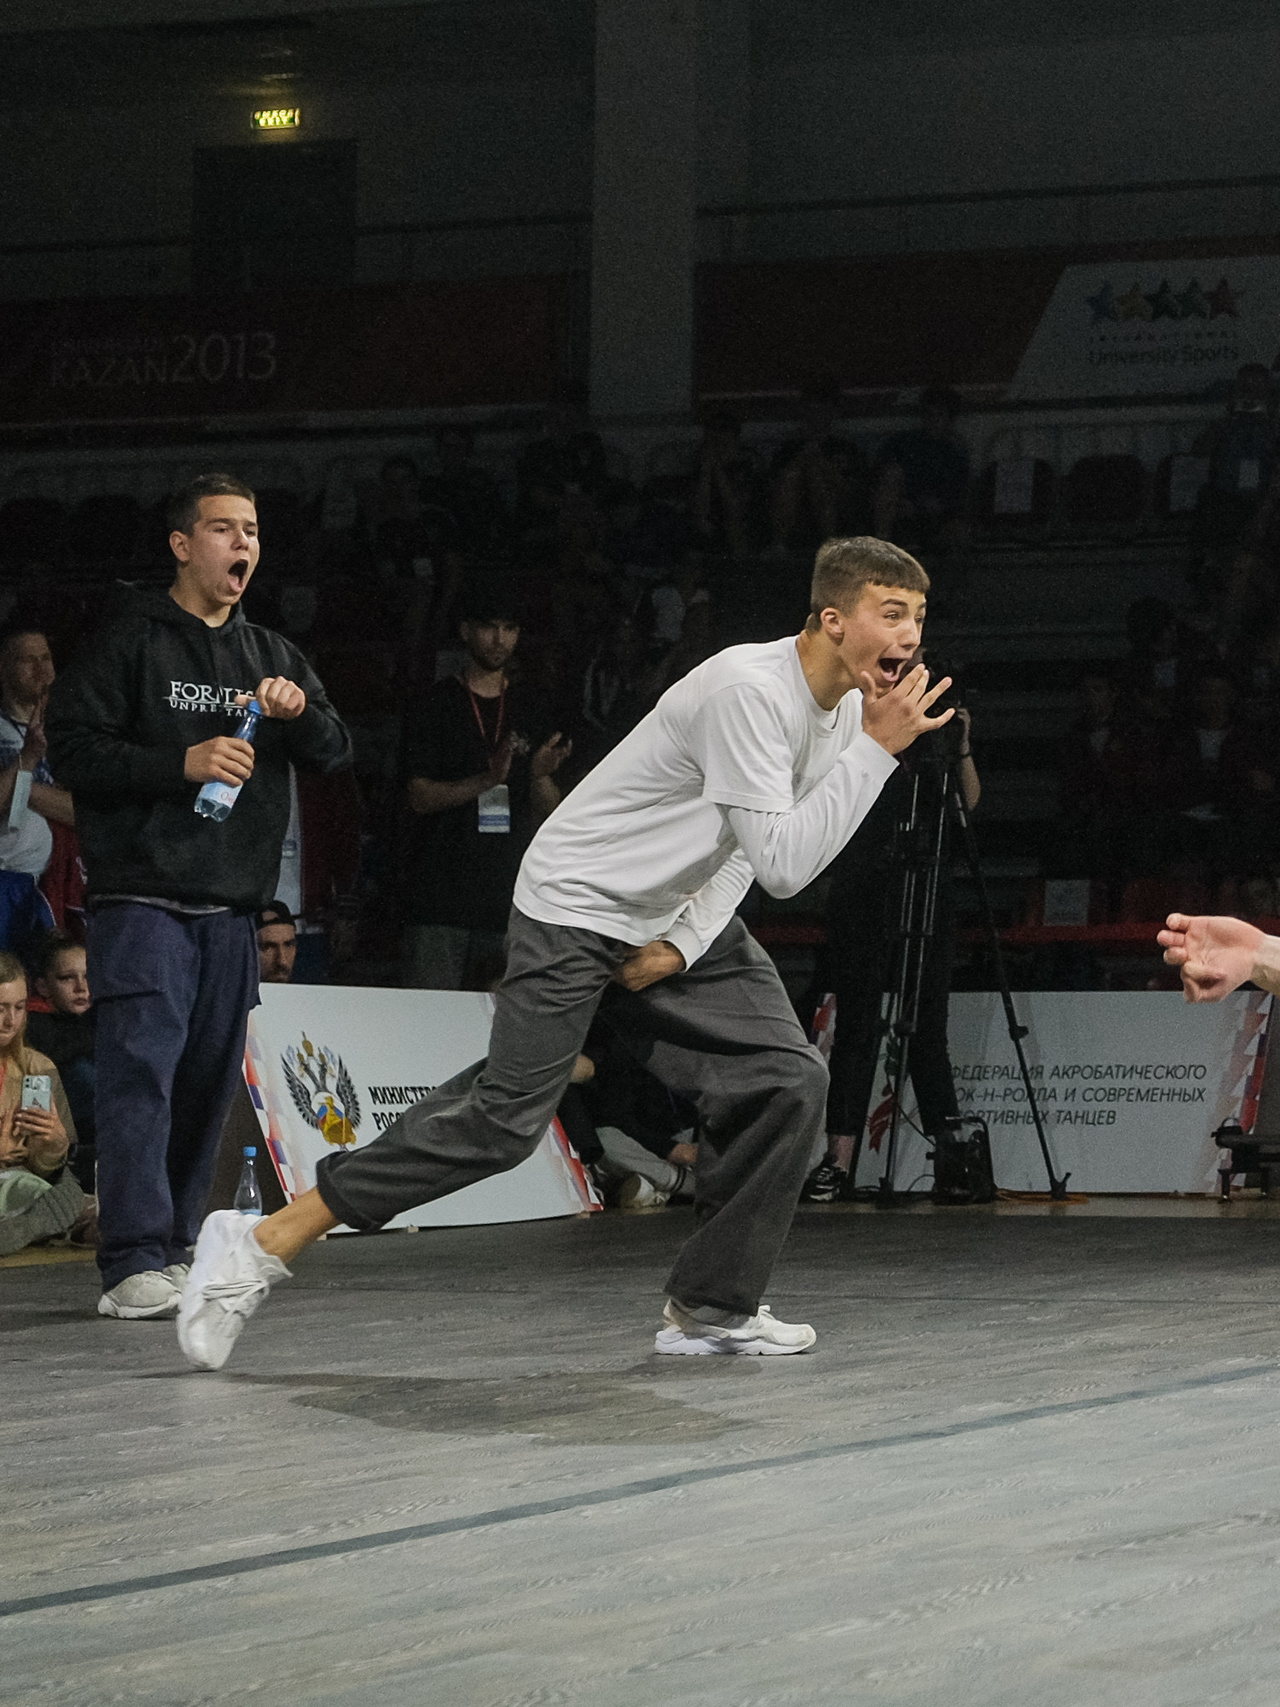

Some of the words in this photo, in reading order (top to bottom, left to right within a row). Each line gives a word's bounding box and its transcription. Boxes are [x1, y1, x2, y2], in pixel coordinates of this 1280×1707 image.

[51, 356, 168, 388] KAZAN
[171, 331, 276, 384] 2013
[1050, 1064, 1207, 1080] АКРОБАТИЧЕСКОГО
[1064, 1087, 1077, 1102] И
[1082, 1087, 1206, 1103] СОВРЕМЕННЫХ
[1056, 1110, 1117, 1126] ТАНЦЕВ
